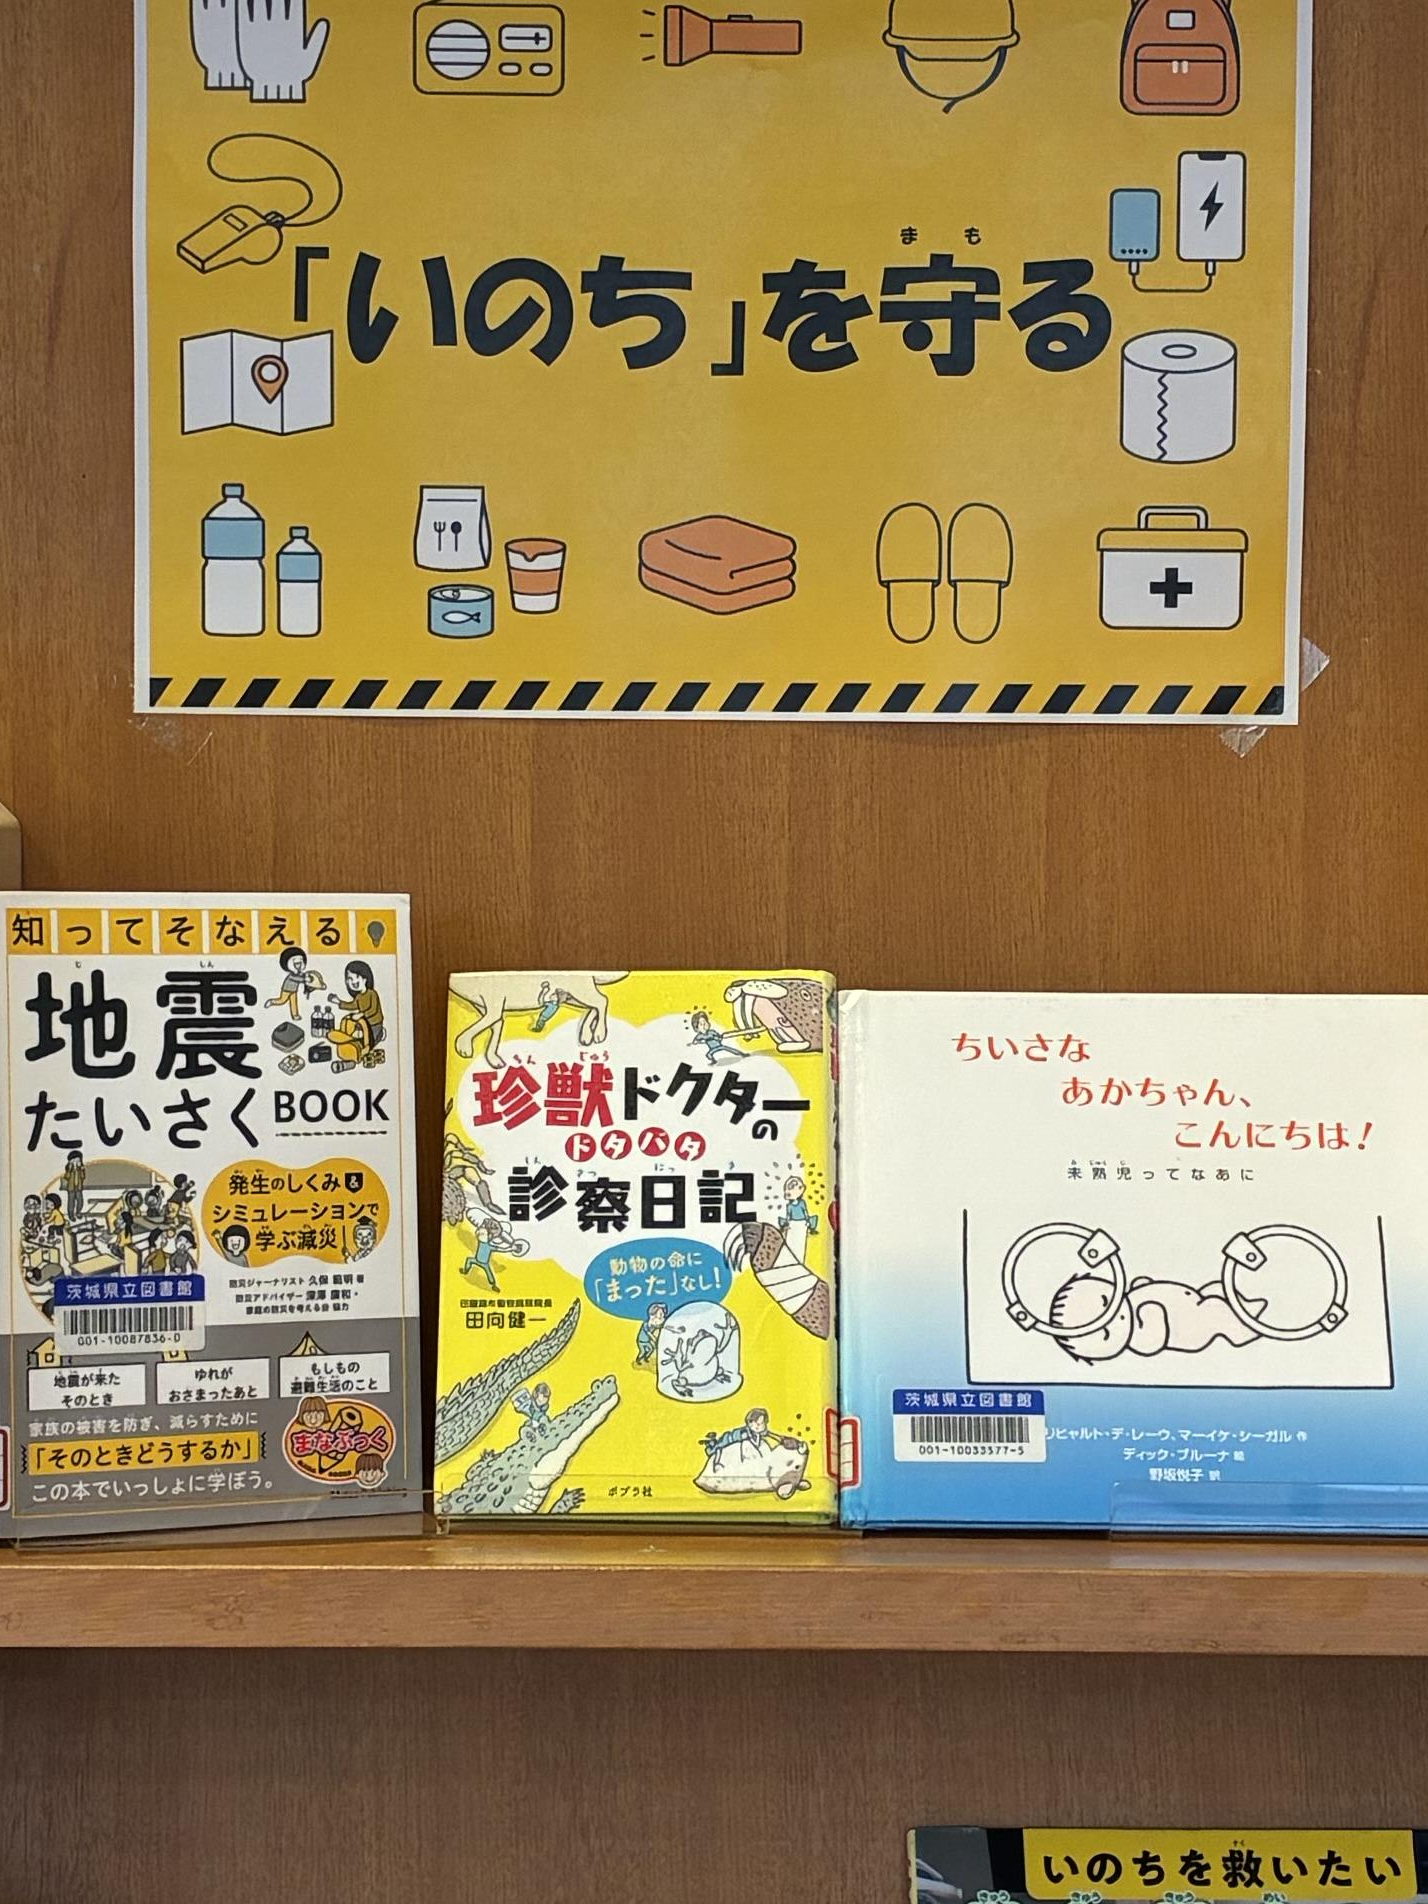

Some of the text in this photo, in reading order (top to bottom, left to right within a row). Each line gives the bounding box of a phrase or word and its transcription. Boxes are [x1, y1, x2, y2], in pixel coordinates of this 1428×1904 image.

[292, 243, 1113, 378] 「いのち」を守る
[10, 912, 342, 949] 知ってそなえる
[25, 967, 264, 1081] 地震
[951, 1031, 1092, 1064] ちいさな
[1060, 1076, 1254, 1109] あかちゃん、
[26, 1087, 389, 1152] たいさく BOOK
[568, 1128, 704, 1162] ドタバタ
[1174, 1119, 1375, 1152] こんにちは!
[229, 1172, 341, 1196] 発生のしくみ
[212, 1202, 379, 1224] シミュレーションで
[507, 1164, 757, 1234] 診察日記
[255, 1228, 338, 1252] 学ぶ減災
[609, 1251, 704, 1276] 動物の命に
[66, 1280, 193, 1300] 茨城県立図書館
[465, 1311, 547, 1330] 田向健一
[53, 1371, 122, 1389] 地震が来た
[194, 1367, 234, 1381] ゆれが
[311, 1360, 361, 1376] もしもの
[61, 1392, 113, 1408] そのとき
[168, 1385, 259, 1401] おさまったあと
[904, 1392, 1033, 1408] 茨城県立図書館
[28, 1410, 260, 1438] 家族の被害を防ぎ、減らすために
[37, 1437, 253, 1470] 「そのときどうするか」
[290, 1427, 387, 1455] まなぶっく
[32, 1470, 274, 1503] この本でいっしょに学ぼう。
[1043, 1847, 1403, 1889] いのちを救いたい
